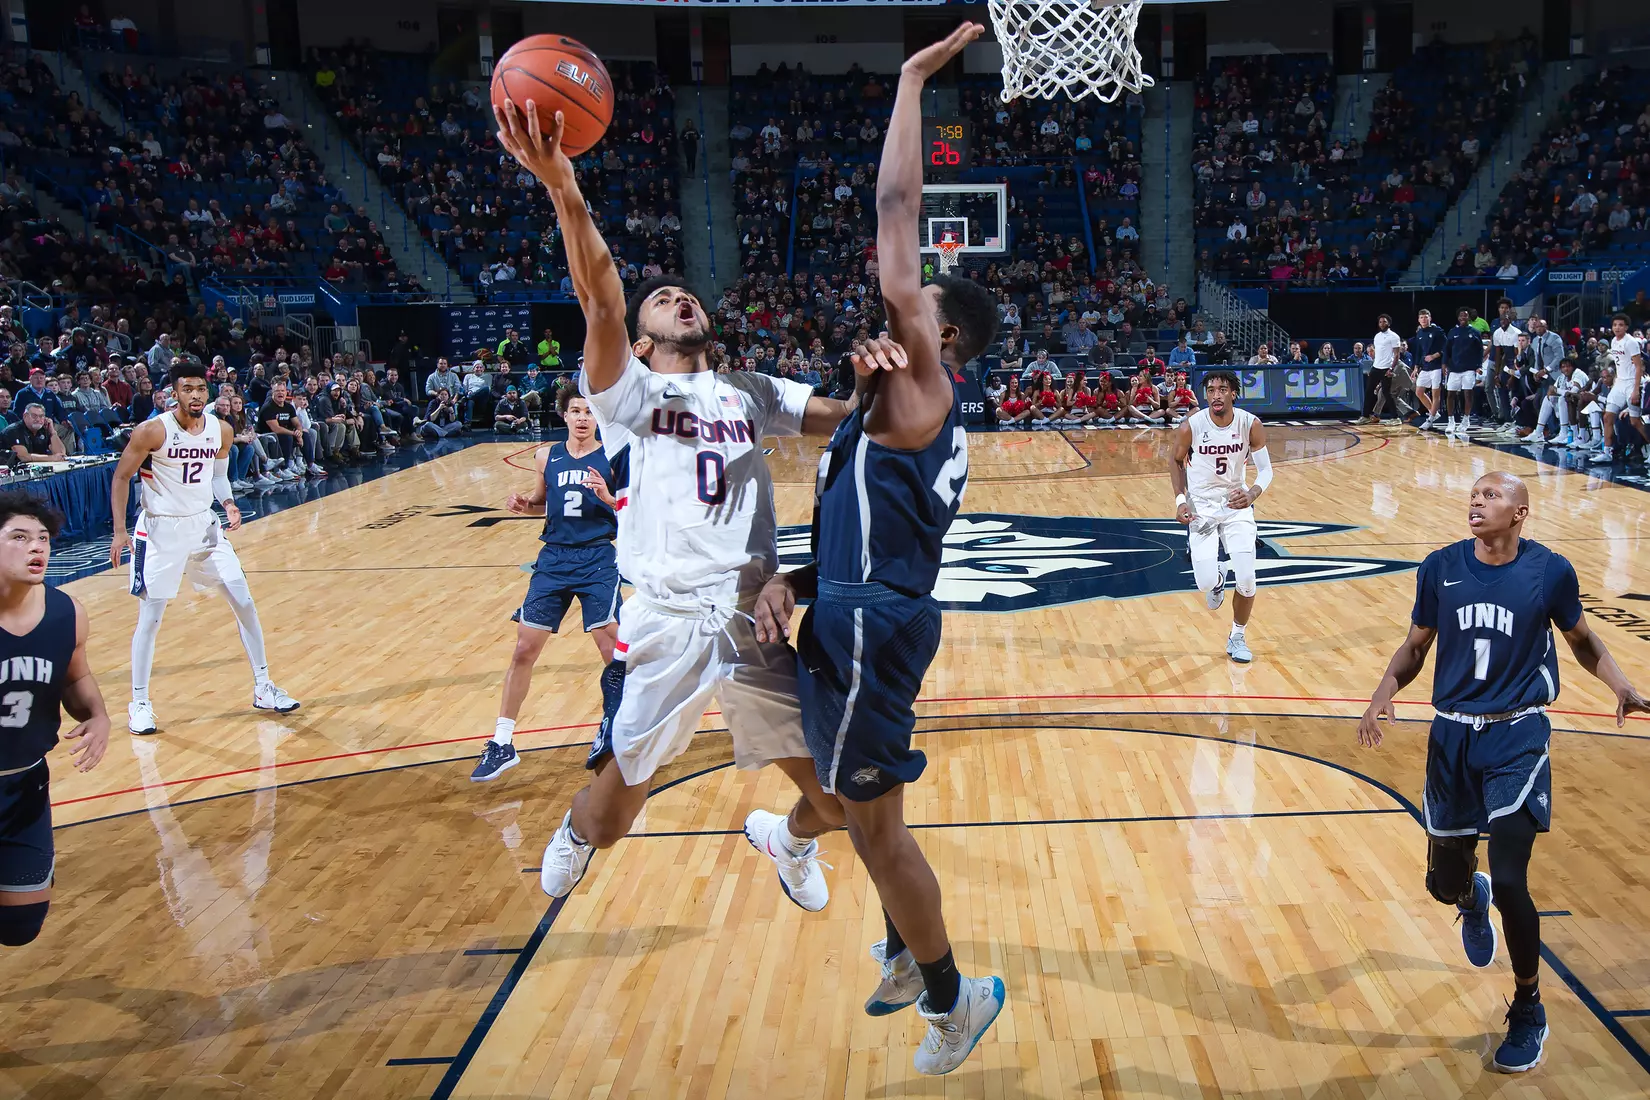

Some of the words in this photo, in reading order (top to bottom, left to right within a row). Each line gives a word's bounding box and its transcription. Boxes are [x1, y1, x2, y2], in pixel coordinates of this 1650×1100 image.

[556, 60, 604, 102] ELITE
[935, 125, 963, 139] 7:58
[931, 141, 961, 165] 26
[280, 295, 295, 304] BUD
[295, 295, 314, 304] LIGHT
[1285, 369, 1340, 387] CBS
[651, 407, 756, 445] UCONN
[167, 447, 219, 459] UCONN
[1199, 442, 1245, 455] UCONN
[182, 461, 204, 484] 12
[696, 450, 727, 506] 0
[1215, 456, 1228, 476] 5
[563, 490, 583, 517] 2
[1456, 602, 1515, 638] UNH
[0, 655, 53, 685] UNH
[1474, 638, 1492, 681] 1
[0, 690, 35, 728] 3
